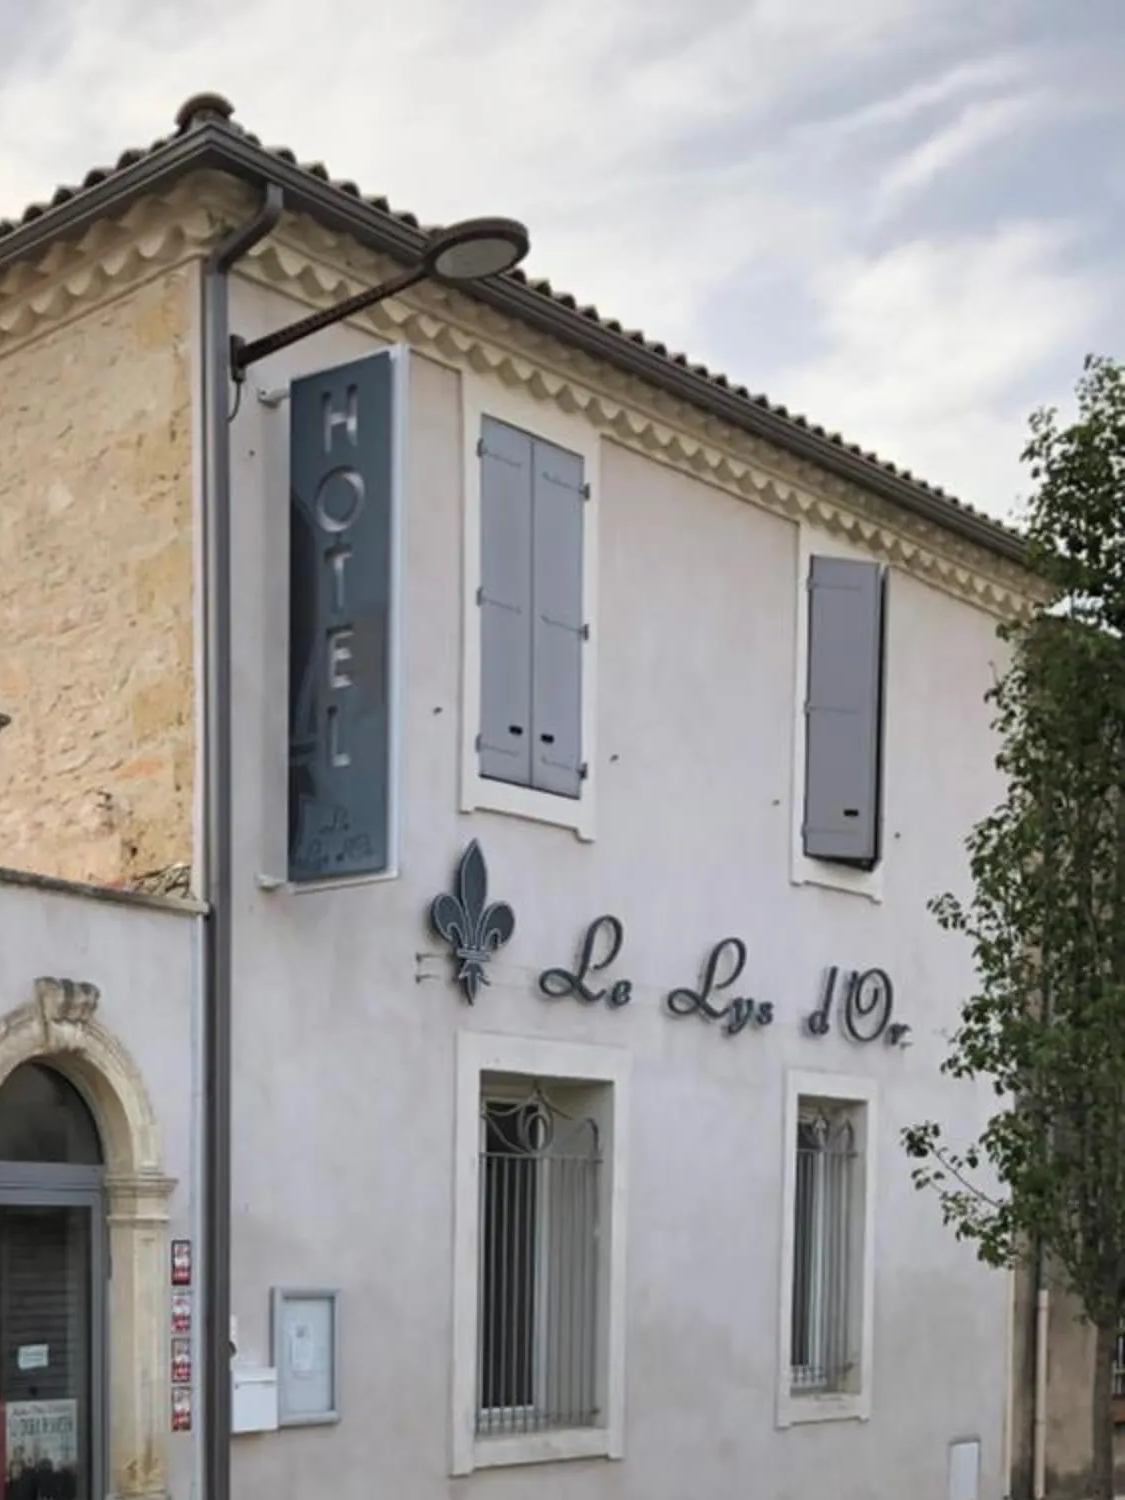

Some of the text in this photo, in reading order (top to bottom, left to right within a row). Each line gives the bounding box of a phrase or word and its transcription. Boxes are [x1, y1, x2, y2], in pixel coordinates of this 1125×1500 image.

[315, 383, 365, 768] HOTEL
[538, 914, 633, 1007] Le
[667, 936, 775, 1035] Lys
